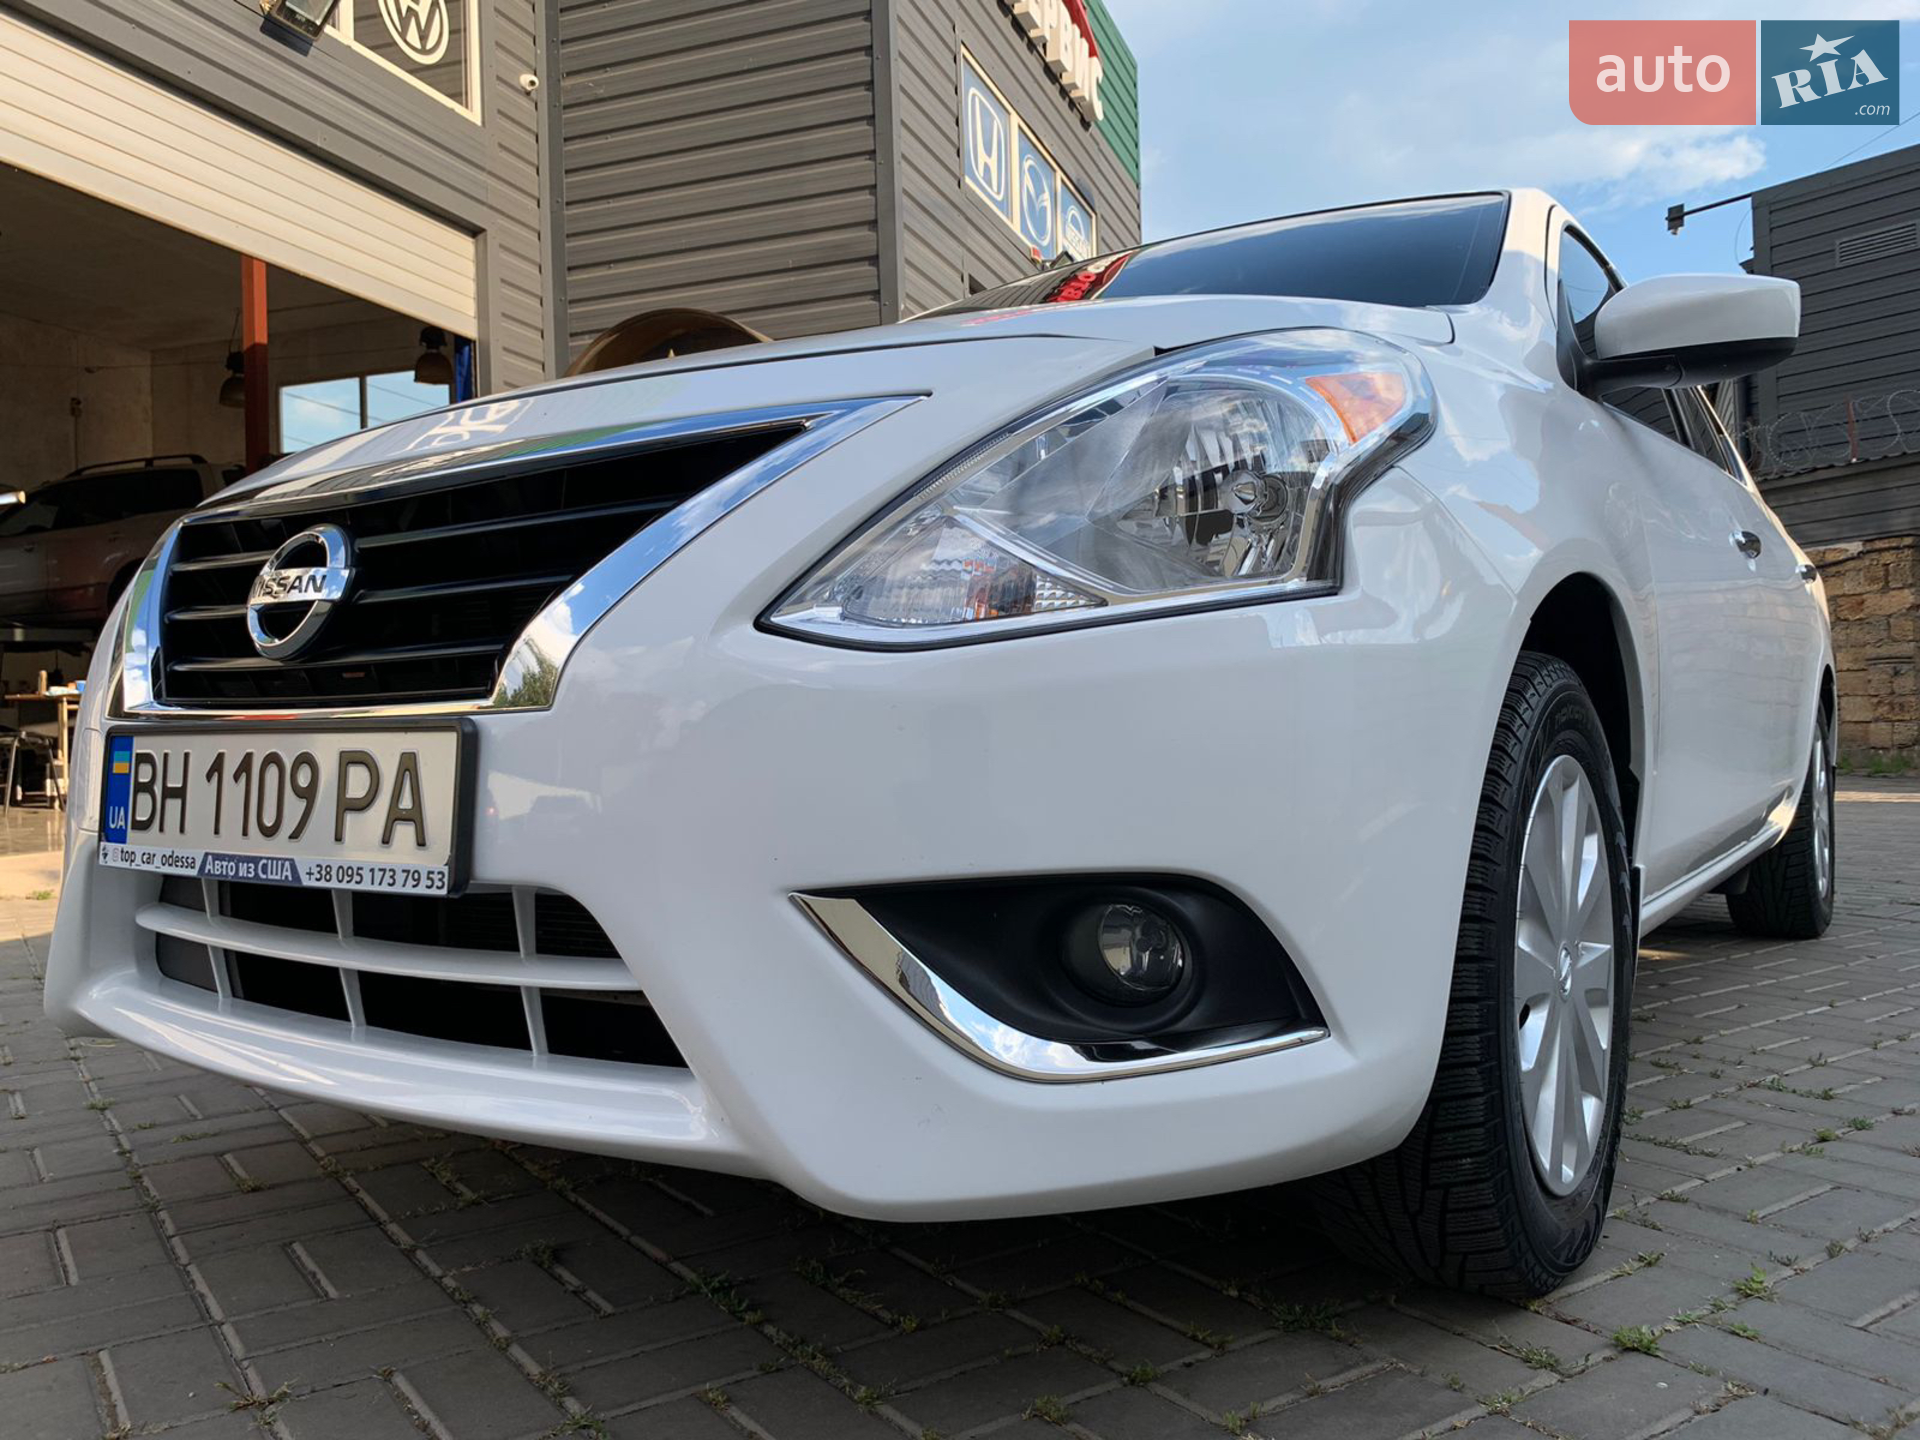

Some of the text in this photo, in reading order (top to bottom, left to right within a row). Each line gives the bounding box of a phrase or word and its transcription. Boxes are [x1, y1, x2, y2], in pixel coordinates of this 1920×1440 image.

[251, 574, 327, 599] NISSAN
[131, 751, 426, 847] BH 1109 PA
[109, 806, 126, 829] UA
[120, 848, 196, 869] top_car_odessa
[205, 855, 292, 881] Авто из США
[305, 864, 446, 889] +38 095 173 79 53
